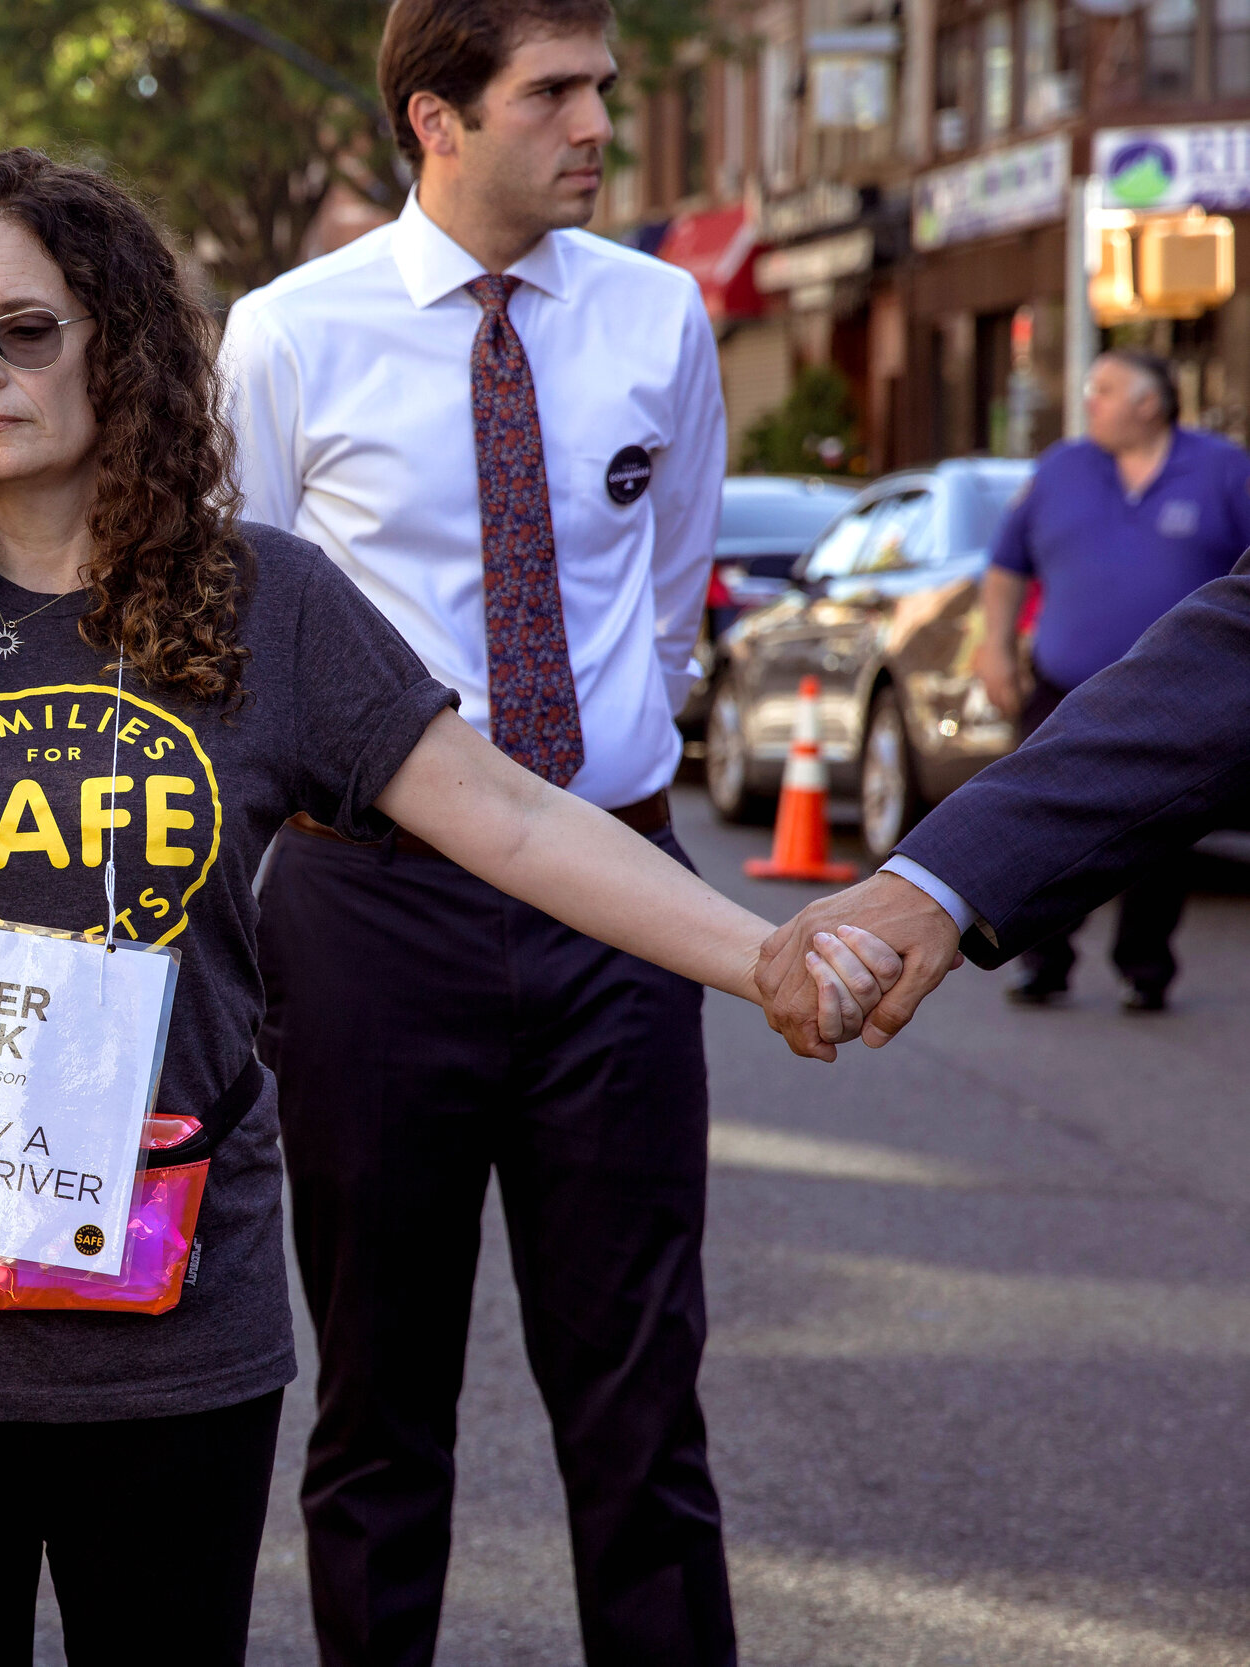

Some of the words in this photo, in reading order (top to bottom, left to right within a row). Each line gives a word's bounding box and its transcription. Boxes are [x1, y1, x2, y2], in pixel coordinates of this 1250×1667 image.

[27, 746, 82, 763] FOR
[22, 1126, 51, 1157] A
[75, 1233, 104, 1248] SAFE
